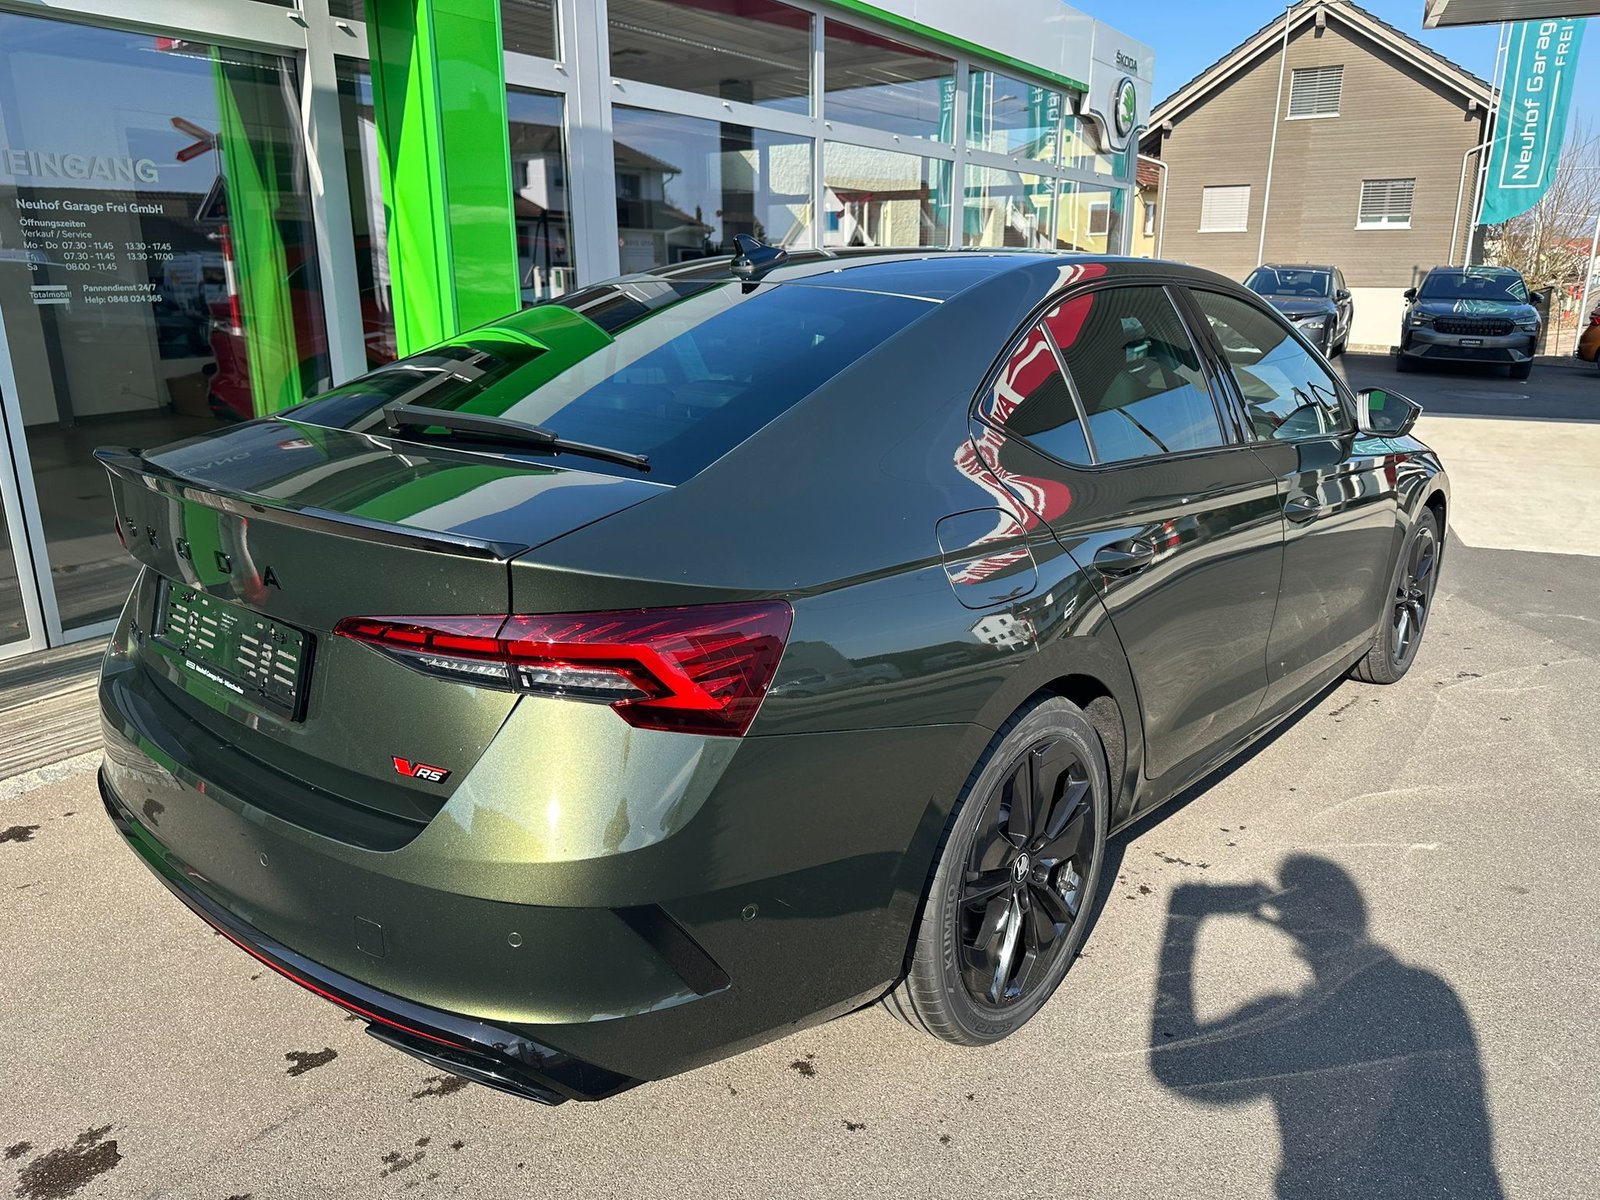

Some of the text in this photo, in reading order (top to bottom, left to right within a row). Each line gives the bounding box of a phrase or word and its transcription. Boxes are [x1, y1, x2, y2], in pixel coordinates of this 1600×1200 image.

[1555, 26, 1574, 67] FREI
[1512, 20, 1557, 180] Neuhof Garag
[6, 149, 160, 184] EINGANG
[15, 198, 164, 214] Neuhof Garage Frei GmbH
[19, 217, 86, 229] Öffnungszeiten
[21, 229, 54, 238] Verkauf
[61, 230, 93, 239] Service
[23, 241, 38, 249] Mo
[45, 241, 58, 249] Do
[61, 241, 87, 250] 07.30
[93, 241, 114, 250] 11.45
[125, 242, 146, 250] 13.30
[63, 252, 89, 260] 07.30
[95, 252, 116, 260] 11.45
[126, 252, 148, 260] 13.30
[153, 252, 174, 260] 17.00
[26, 262, 38, 271] Sa
[65, 262, 91, 271] 08.00
[97, 262, 118, 271] 11.45
[82, 283, 156, 292] Pannendienst 24/7
[84, 296, 106, 305] Help:
[130, 295, 146, 303] 024
[943, 883, 956, 971] KUMHO
